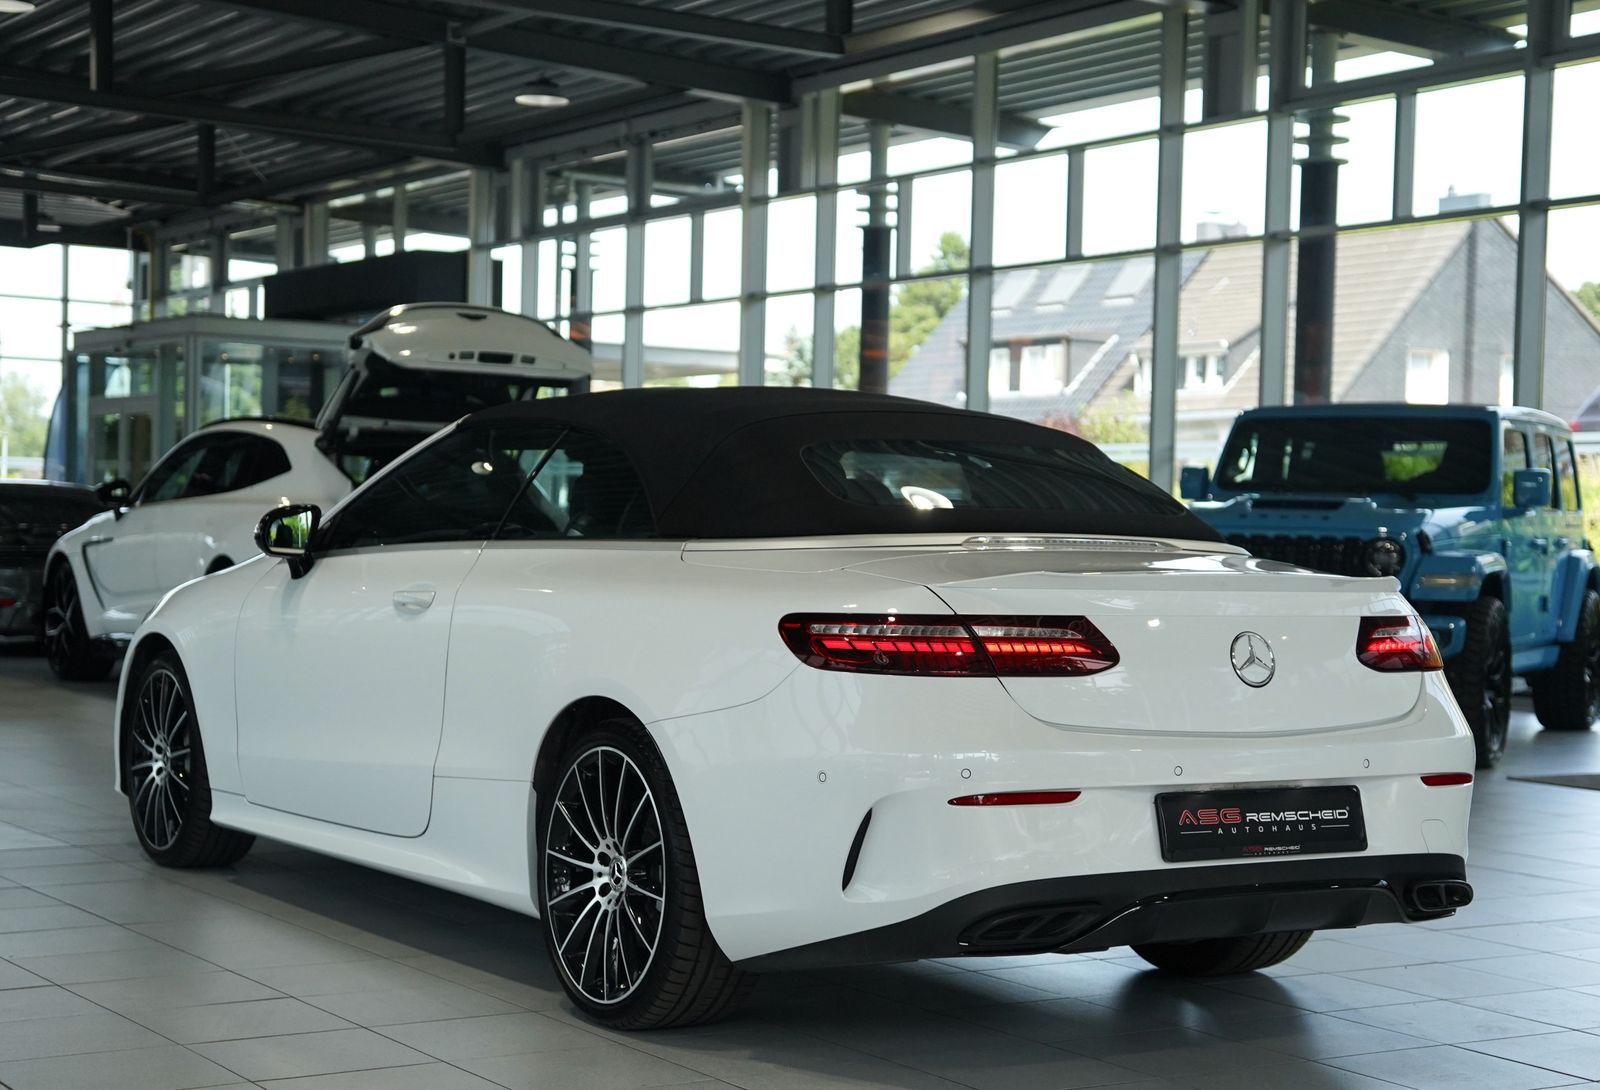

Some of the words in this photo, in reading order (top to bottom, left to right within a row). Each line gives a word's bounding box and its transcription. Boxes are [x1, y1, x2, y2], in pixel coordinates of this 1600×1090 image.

[1179, 808, 1242, 826] ASG
[1246, 808, 1349, 823] REMSCHEID
[1217, 824, 1317, 835] AUTOHAUS
